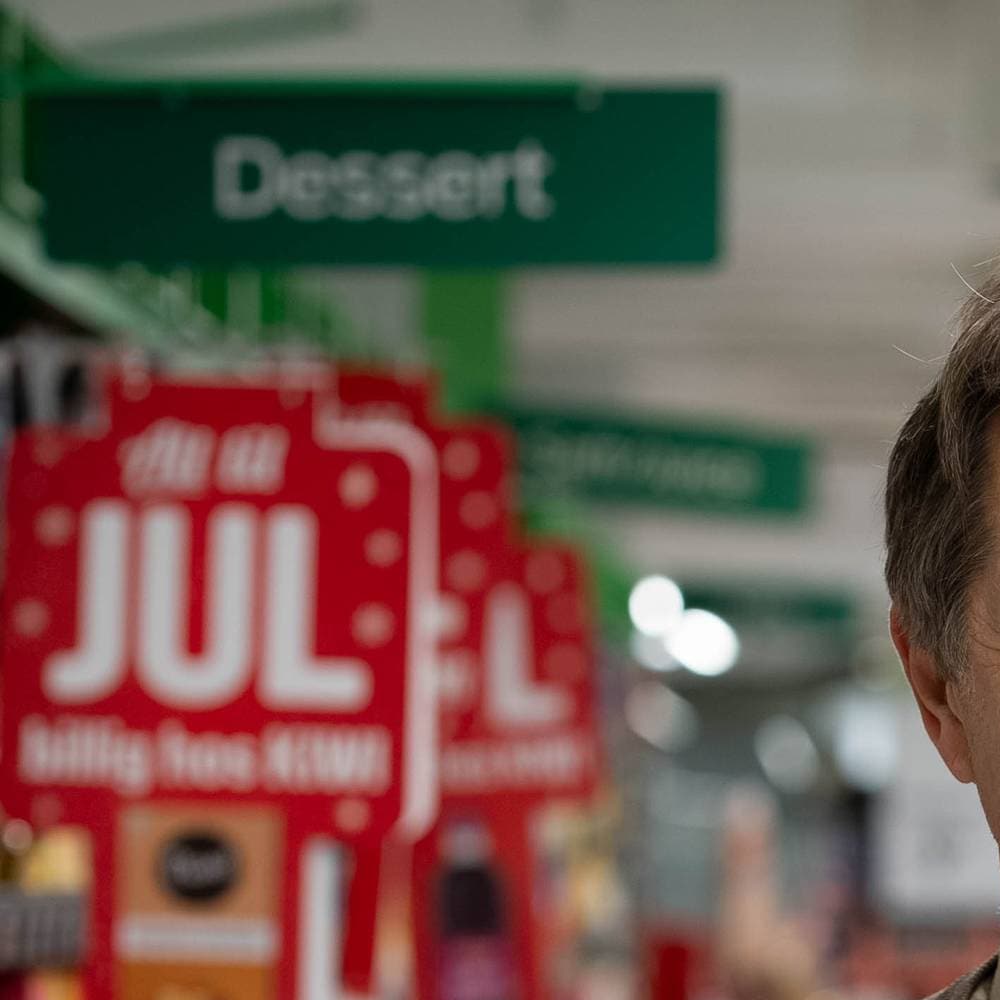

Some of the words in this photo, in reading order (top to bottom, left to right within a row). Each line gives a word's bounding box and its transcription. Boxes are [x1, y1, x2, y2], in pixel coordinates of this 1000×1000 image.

[212, 135, 554, 221] Dessert
[42, 499, 373, 713] JUL
[18, 713, 152, 796] billig
[154, 718, 258, 790] hos
[262, 721, 391, 794] KIWI
